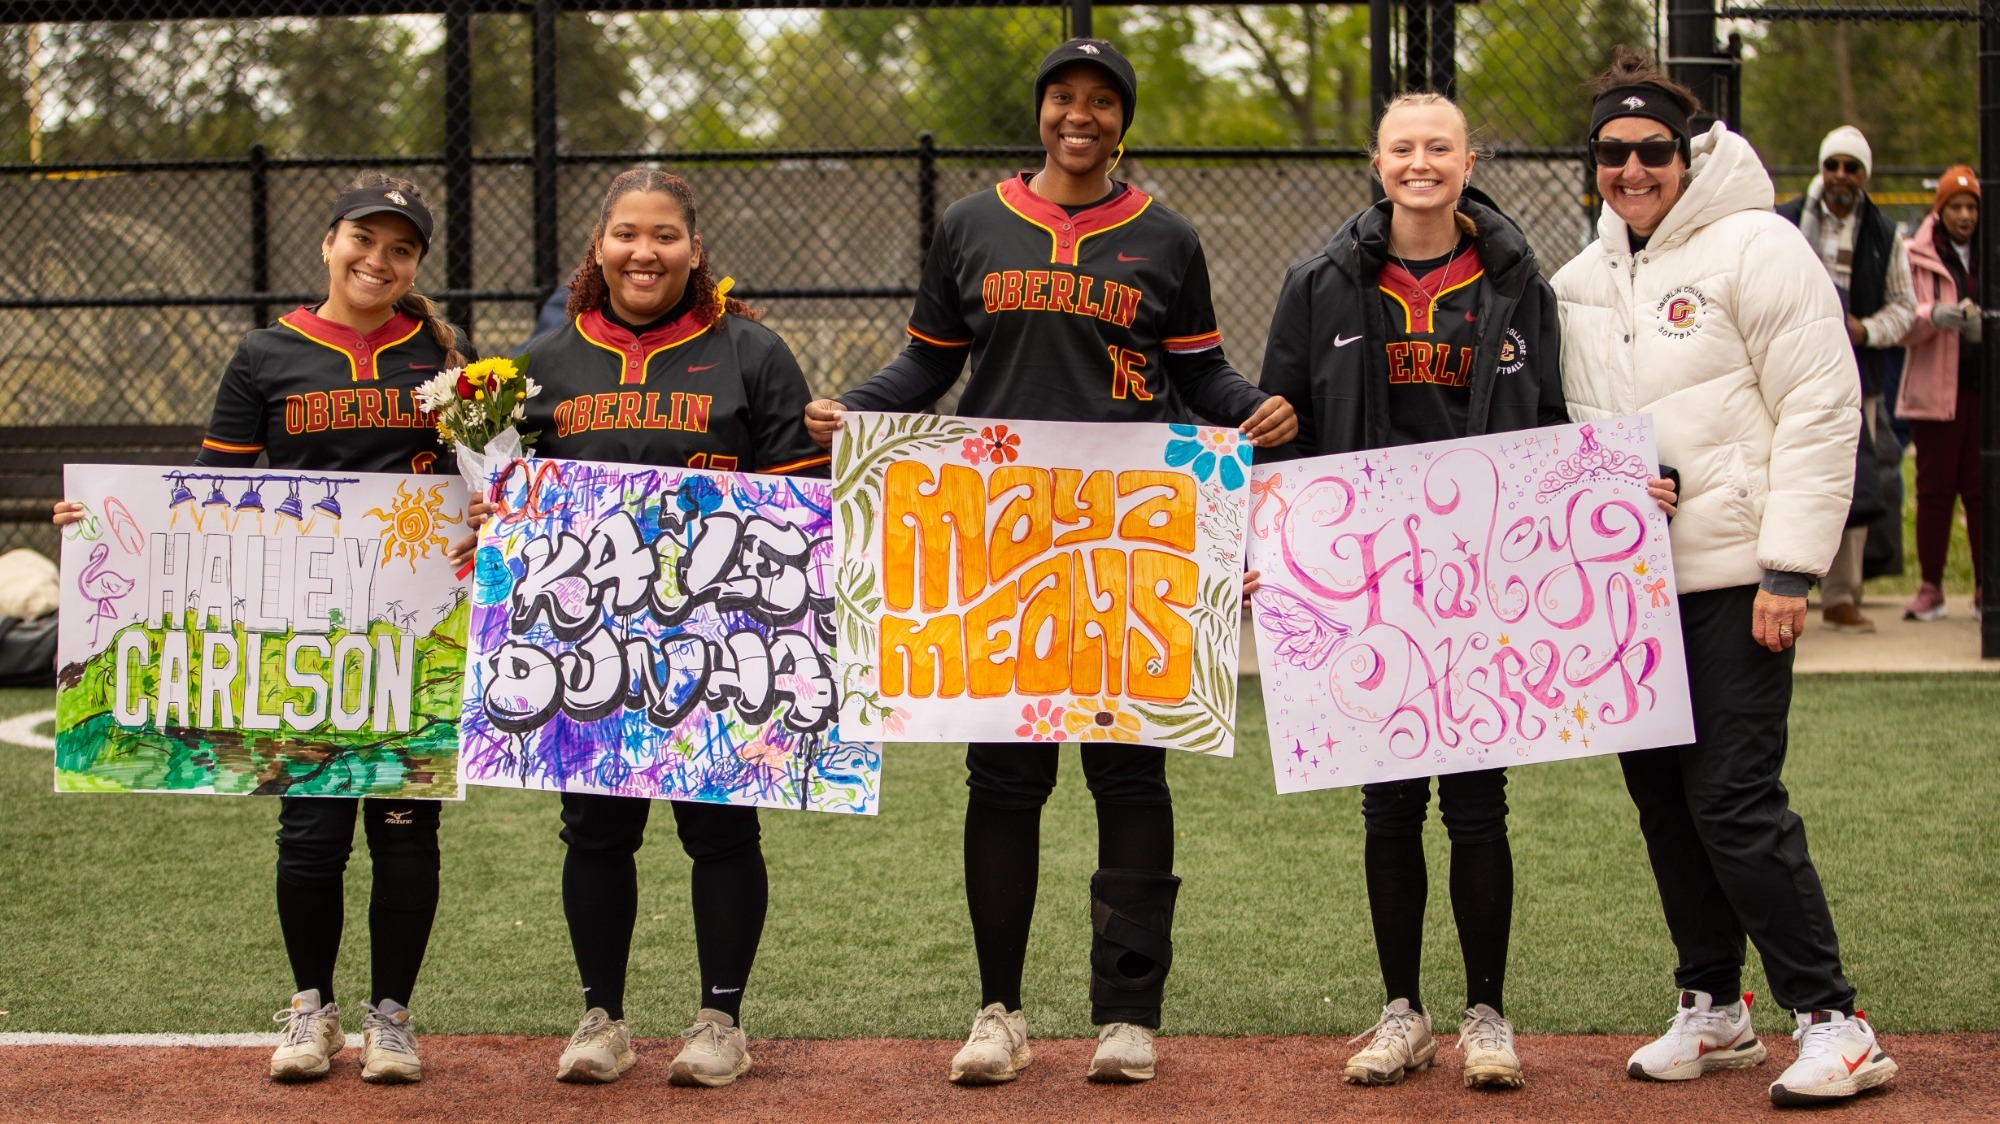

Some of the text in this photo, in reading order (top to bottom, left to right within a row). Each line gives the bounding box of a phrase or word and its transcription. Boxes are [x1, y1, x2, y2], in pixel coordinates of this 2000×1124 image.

[982, 270, 1142, 328] OBERLIN
[1657, 286, 1708, 312] OBERLIN COLLEGE
[1657, 324, 1703, 340] SOFTBALL
[1107, 345, 1153, 401] 15
[1386, 341, 1473, 387] ERLI
[1496, 361, 1525, 375] FTBALL
[285, 388, 439, 435] OBERLI
[554, 391, 712, 438] OBERLIN
[1280, 447, 1648, 636] Hailey
[147, 532, 382, 634] HALEY
[114, 630, 415, 733] CARLSON
[483, 626, 838, 734] DUNHA
